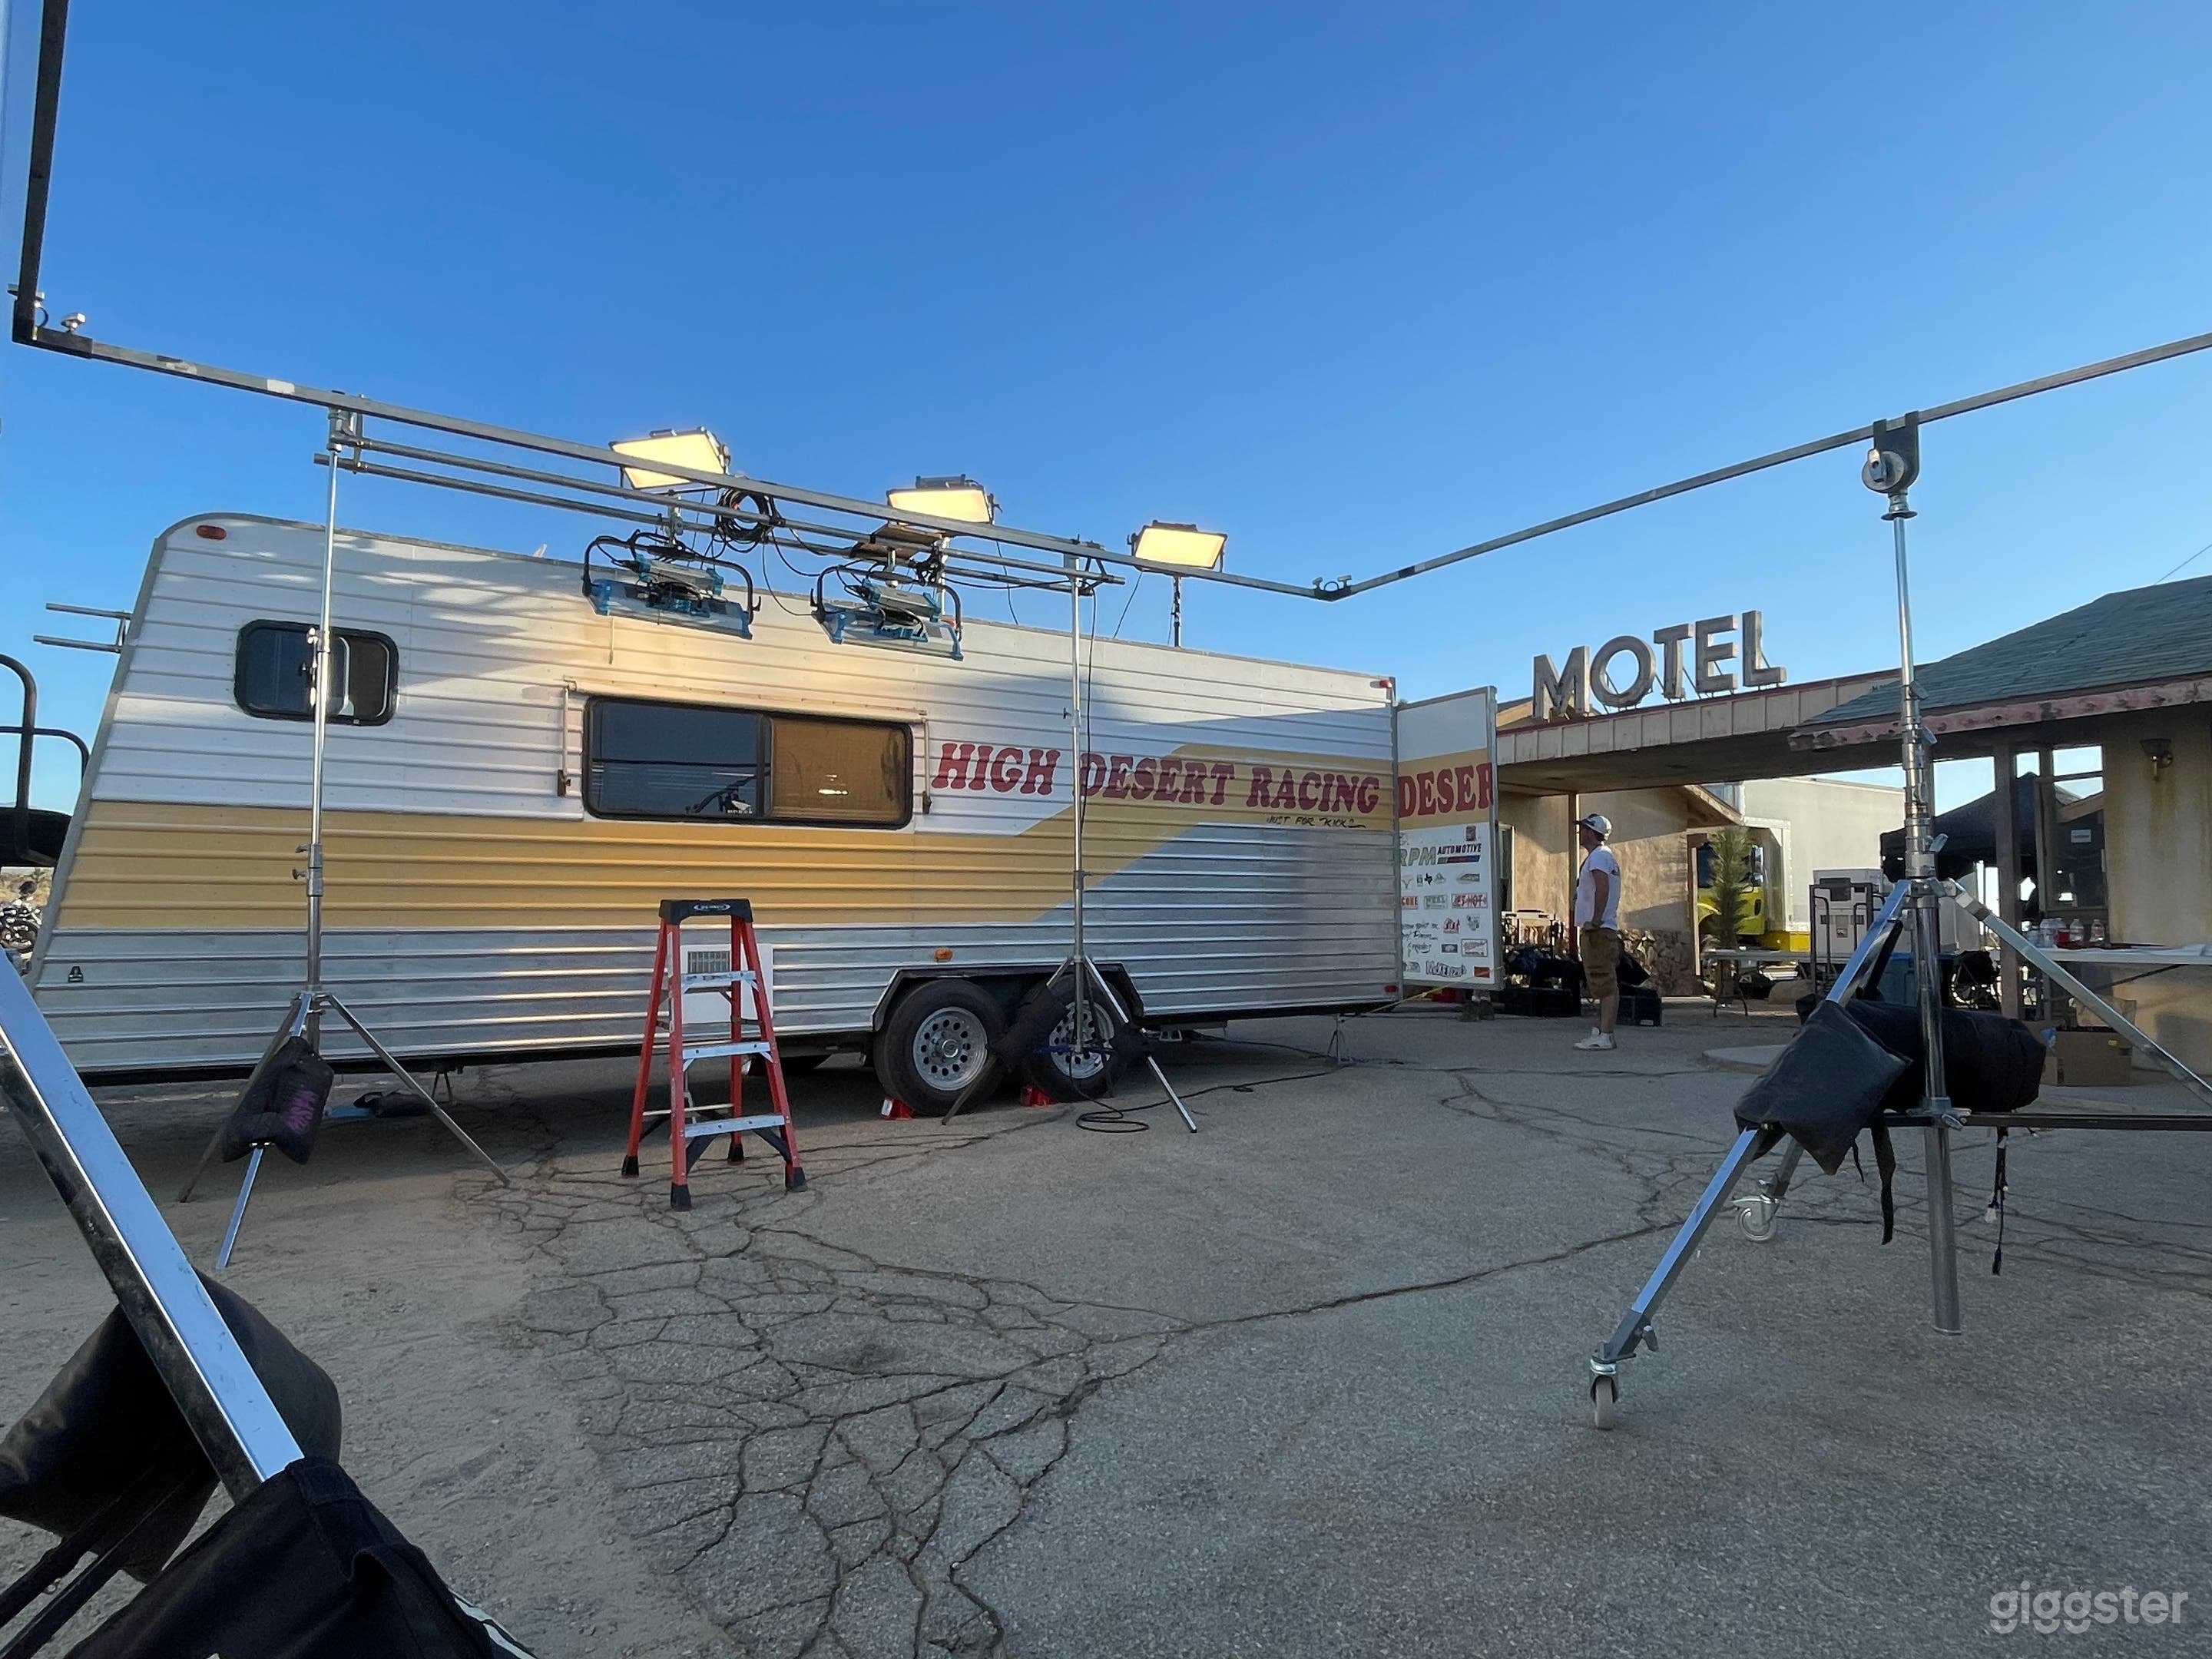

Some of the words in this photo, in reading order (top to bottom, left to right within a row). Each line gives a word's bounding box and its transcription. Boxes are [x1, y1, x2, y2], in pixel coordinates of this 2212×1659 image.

[1533, 610, 1786, 720] MOTEL
[932, 743, 1061, 795] HIGH
[1073, 752, 1235, 805] DESERT
[1246, 768, 1379, 813] RACING
[1295, 816, 1315, 826] FOR
[1400, 846, 1436, 866] RPM
[1437, 843, 1482, 855] AUTOMOTIVE
